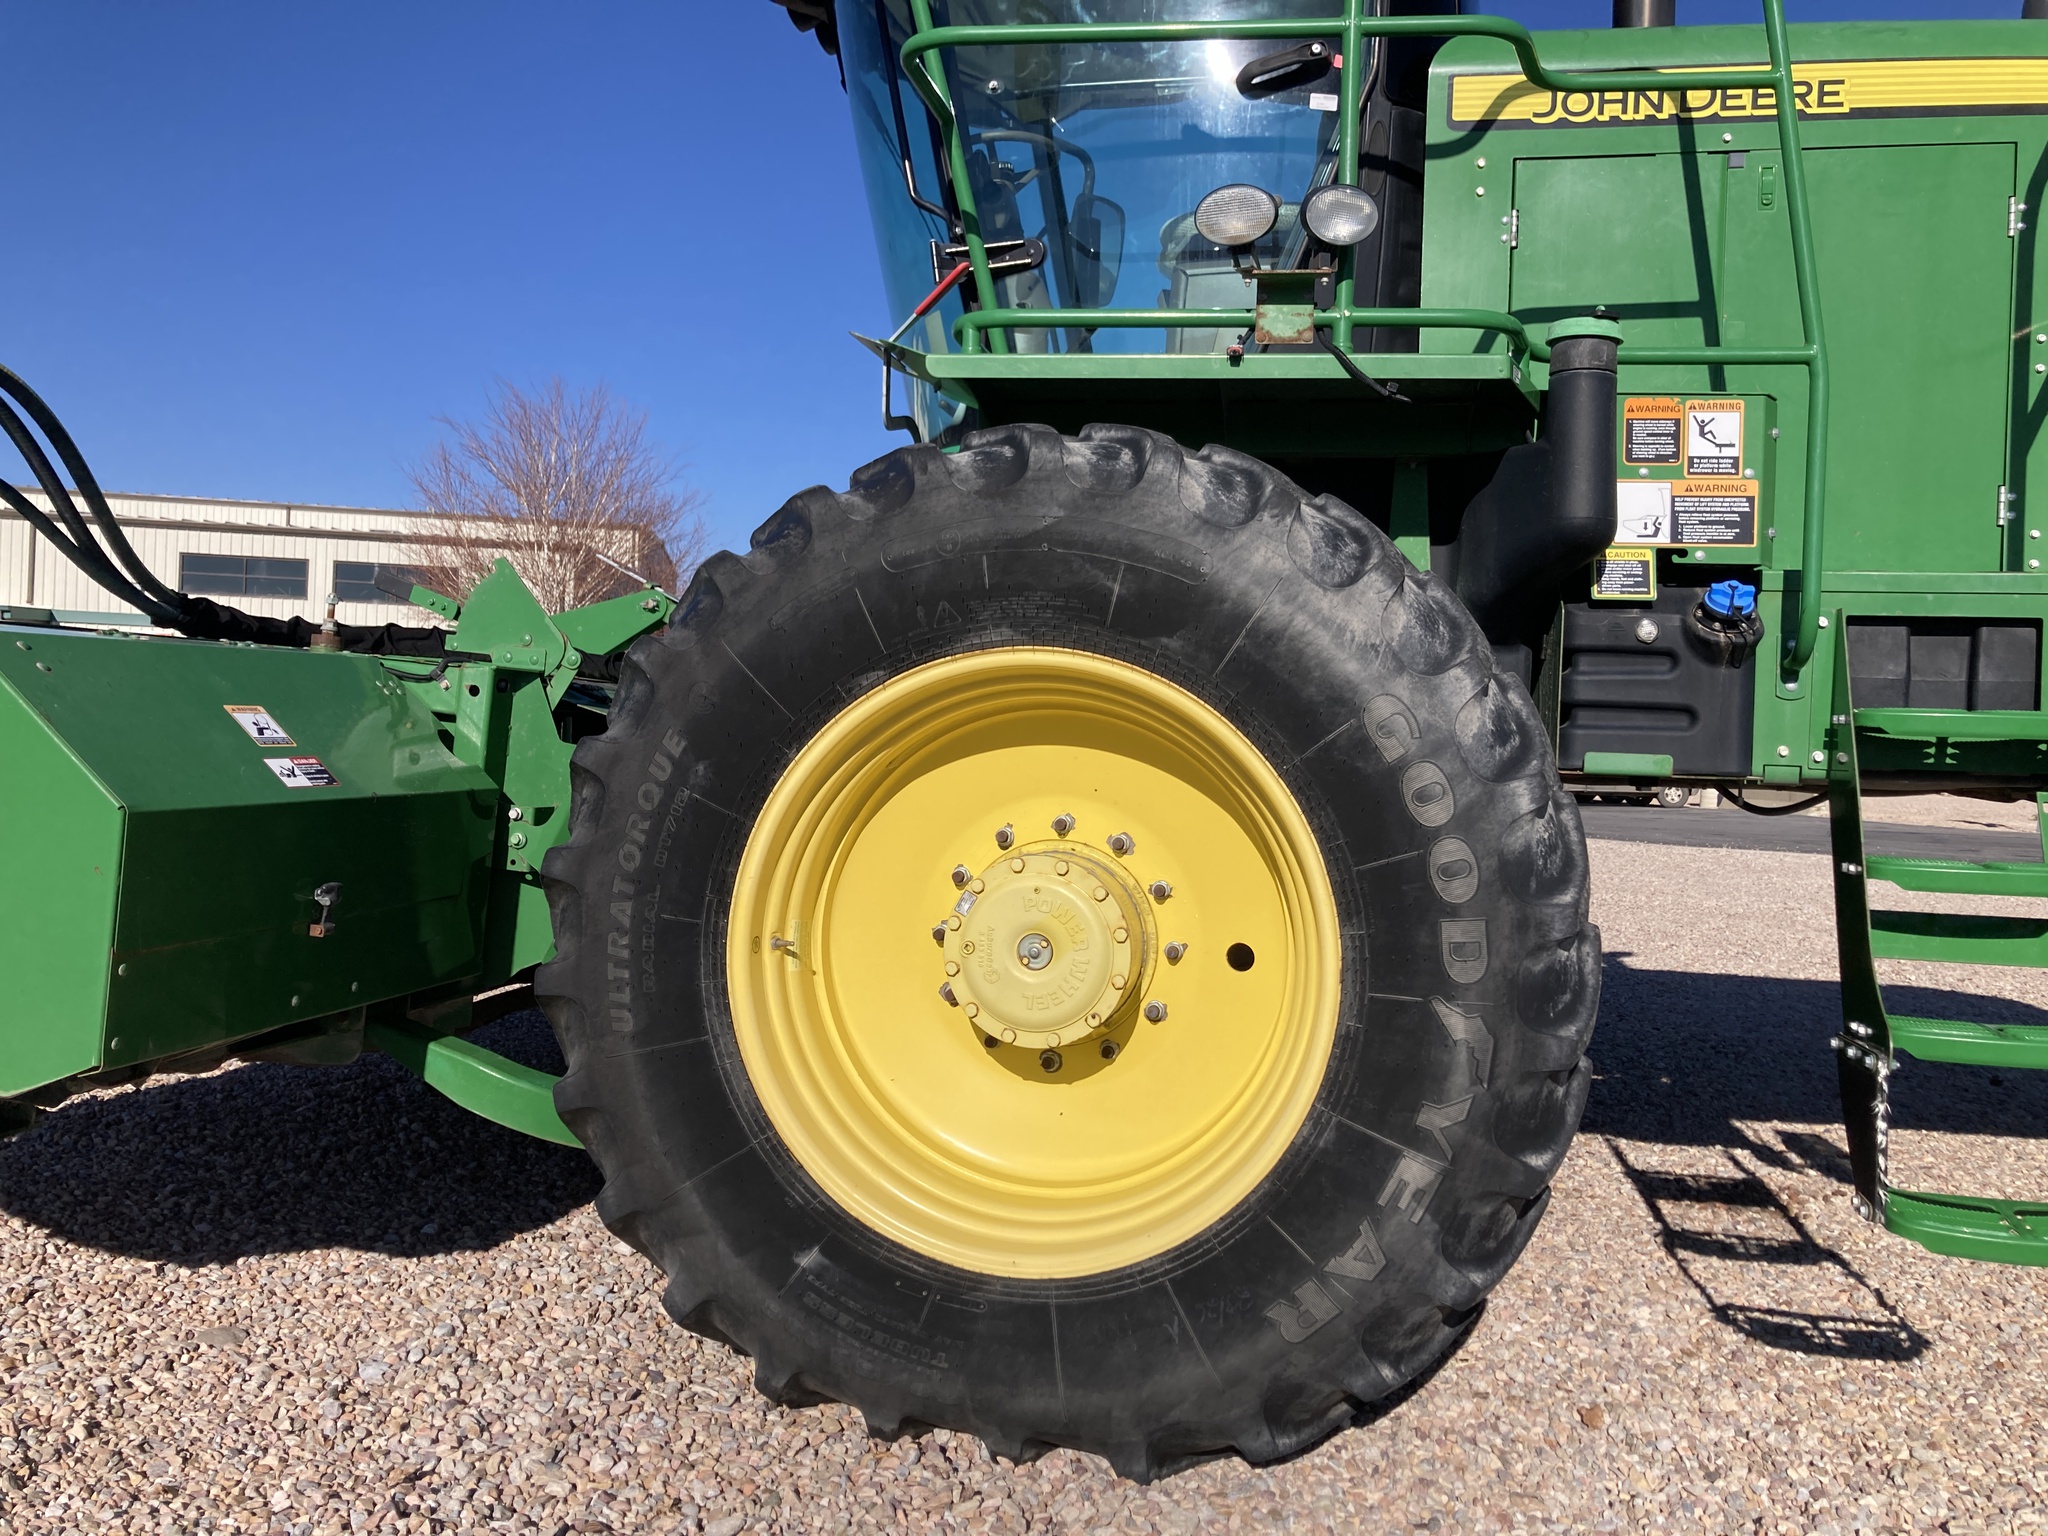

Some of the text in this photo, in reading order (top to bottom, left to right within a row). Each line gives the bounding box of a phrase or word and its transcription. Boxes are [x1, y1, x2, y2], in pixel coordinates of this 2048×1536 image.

[1532, 79, 1846, 119] JOHN DEERE
[1635, 405, 1681, 413] WARNING
[1698, 402, 1741, 411] WARNING
[1694, 484, 1747, 493] WARNING
[607, 726, 689, 1034] ULTRATORQUE
[1022, 896, 1090, 950] POWER
[1022, 957, 1091, 1011] WHEEL
[1264, 693, 1494, 1344] GOODYEAR
